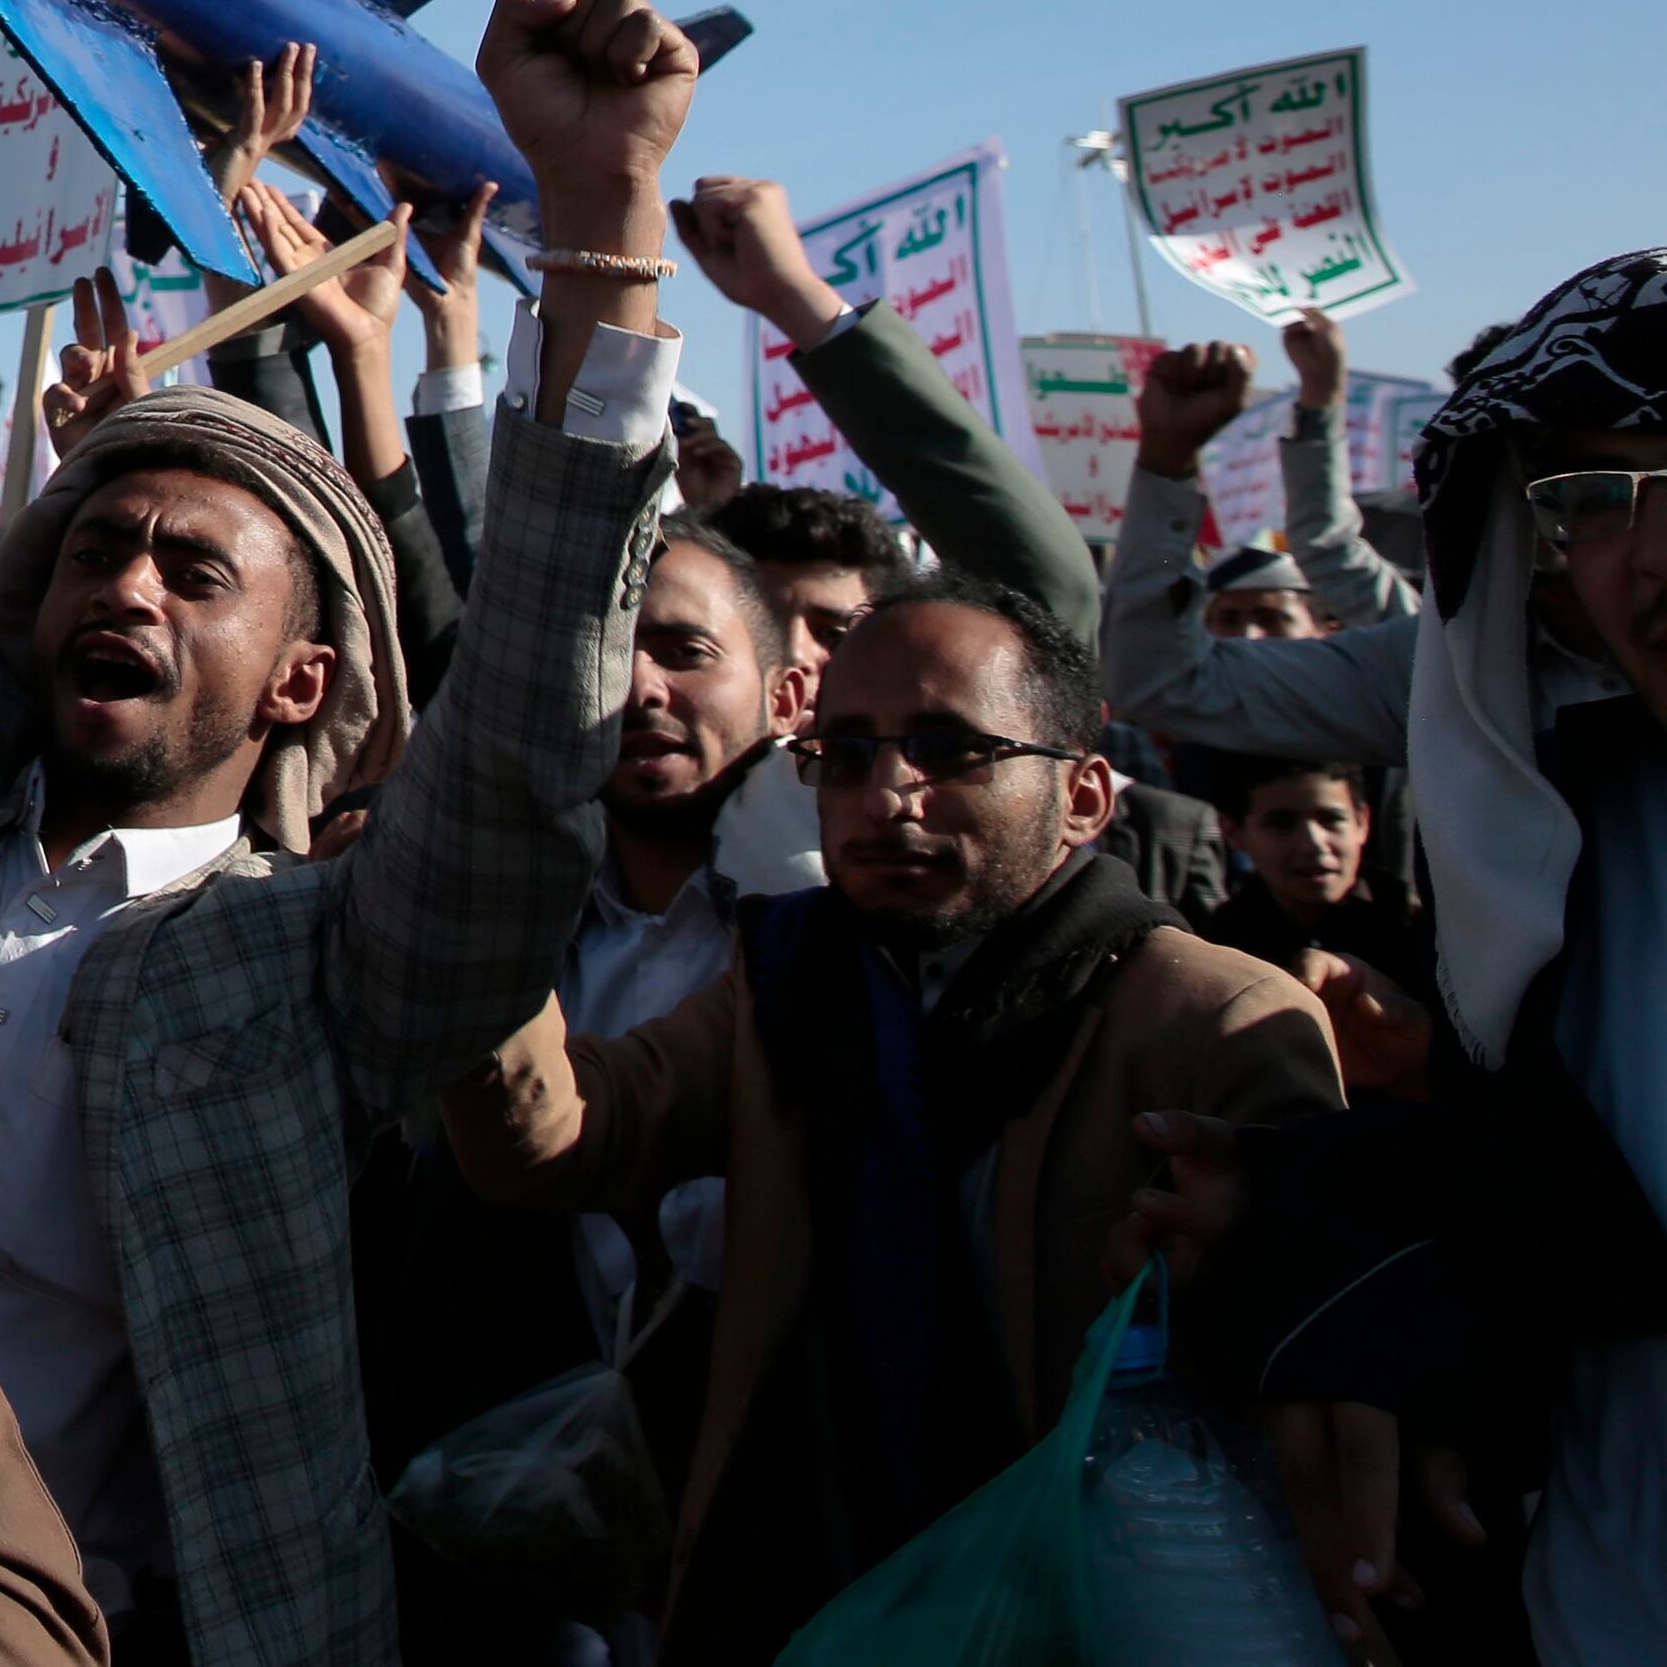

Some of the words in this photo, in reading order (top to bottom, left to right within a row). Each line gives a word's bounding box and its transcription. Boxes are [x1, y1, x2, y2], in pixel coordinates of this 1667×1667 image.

[1269, 72, 1347, 113] الله
[1144, 82, 1262, 152] أكبر
[1257, 114, 1345, 155] الموت
[1261, 150, 1347, 194] الموت
[894, 192, 965, 262] الله
